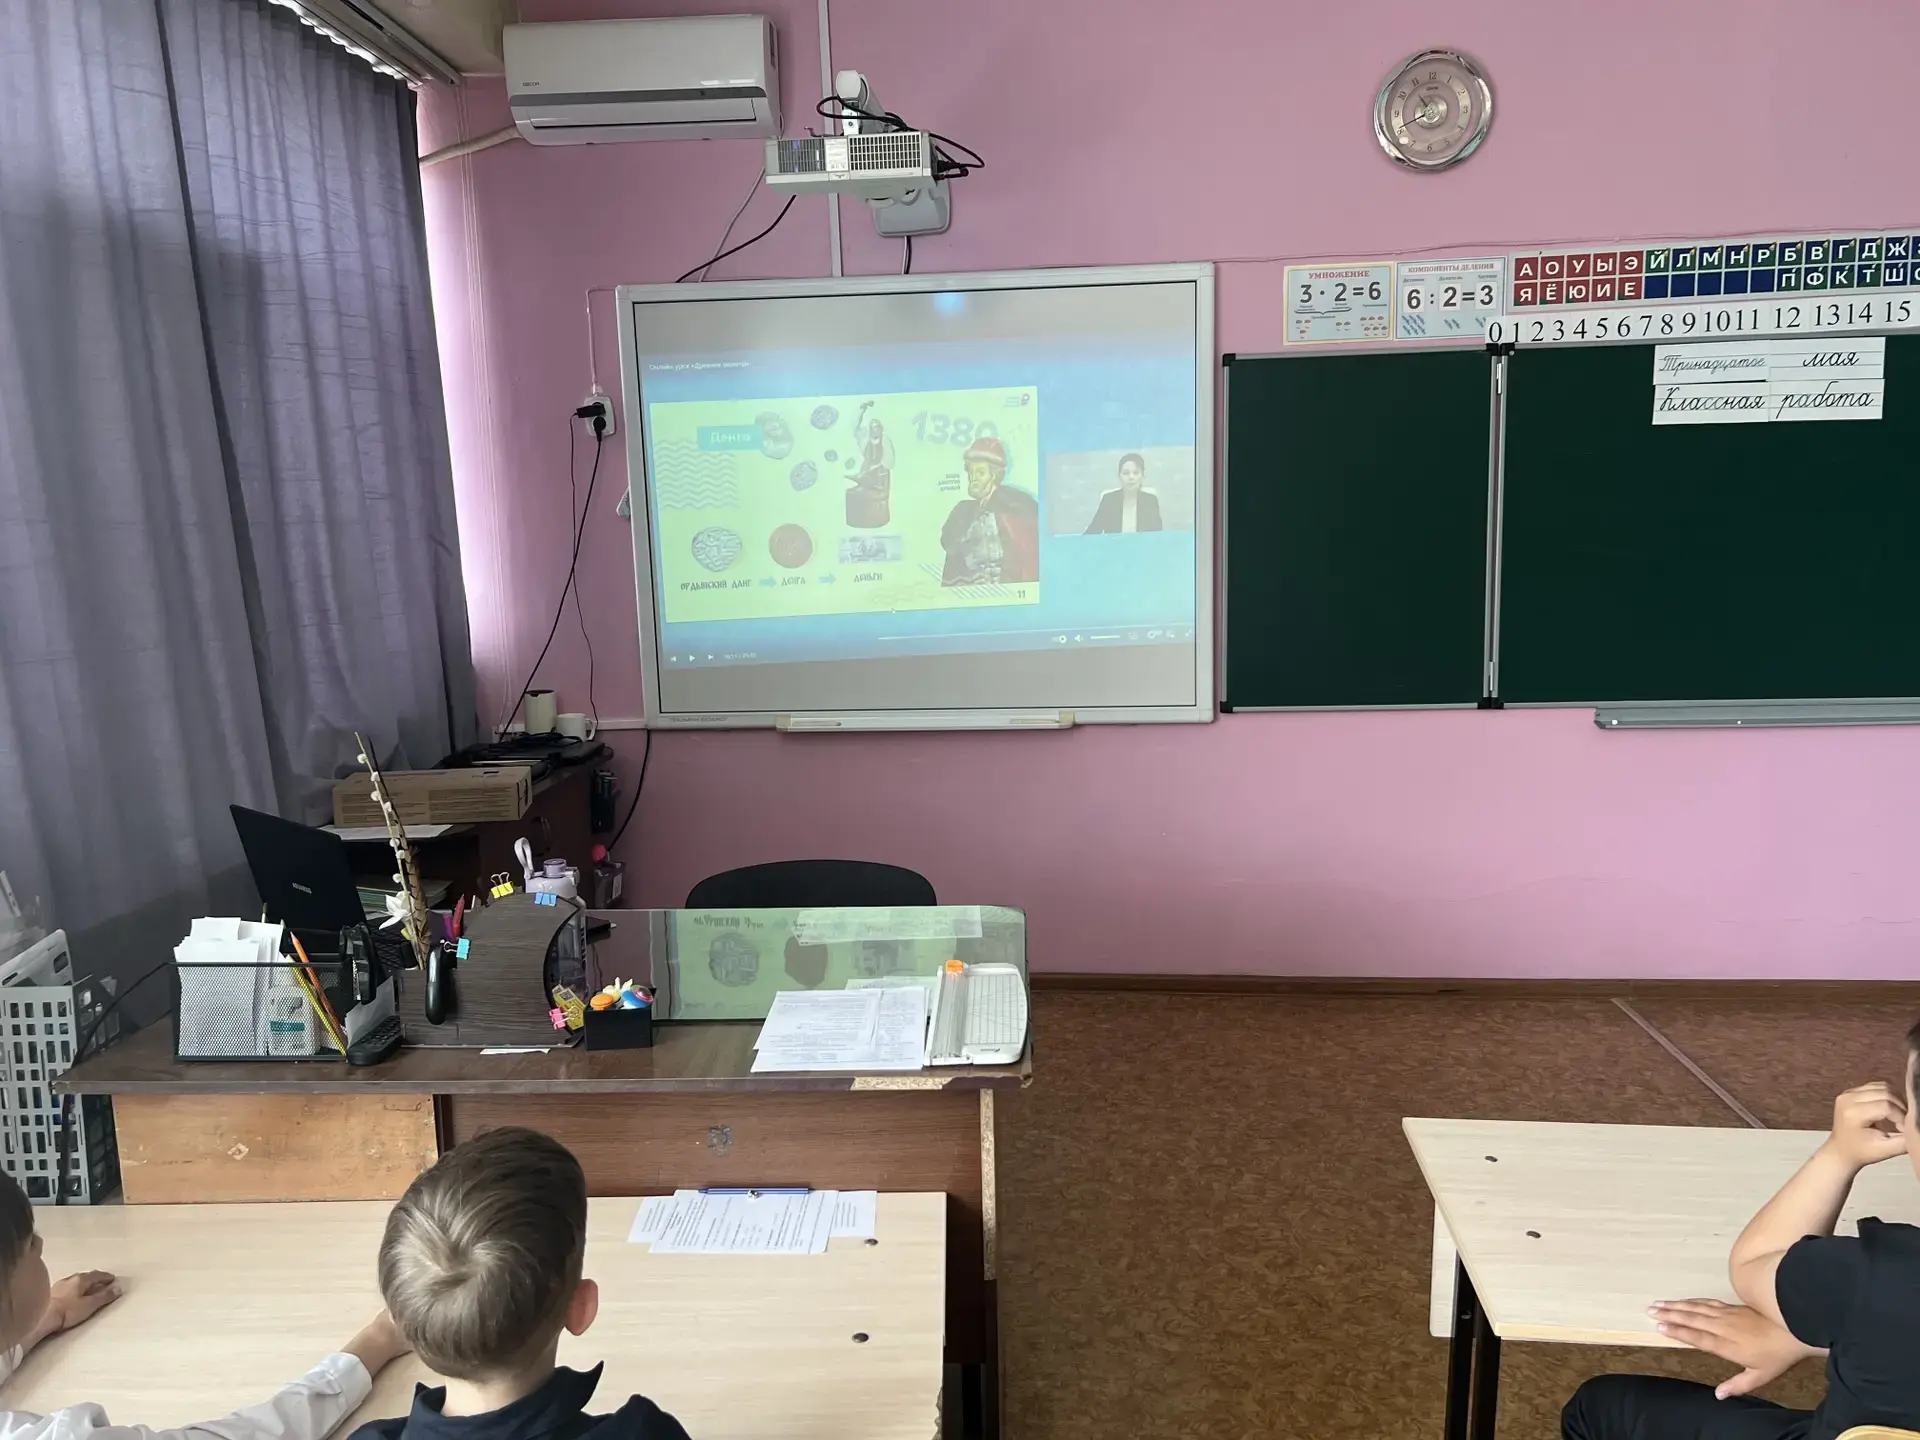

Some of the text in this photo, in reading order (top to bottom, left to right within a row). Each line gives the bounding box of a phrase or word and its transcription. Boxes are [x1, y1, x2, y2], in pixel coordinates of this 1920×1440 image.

[1428, 71, 1437, 80] 12
[1411, 77, 1419, 87] 11
[1398, 91, 1407, 100] 10
[1394, 110, 1400, 118] 9
[1463, 105, 1469, 114] 3
[1410, 140, 1416, 148] 7
[1427, 143, 1433, 152] 6
[1520, 263, 1533, 276] А
[1545, 261, 1560, 275] О
[1572, 259, 1585, 273] У
[1596, 258, 1613, 272] Ы
[1624, 256, 1638, 270] Э
[1650, 251, 1665, 269] Й
[1676, 253, 1690, 268] Л
[1703, 252, 1720, 266] М
[1730, 250, 1744, 265] Н
[1757, 249, 1770, 263] Р
[1784, 247, 1796, 261] Б
[1811, 246, 1823, 260] В
[1838, 244, 1849, 258] Г
[1862, 242, 1877, 259] Д
[1887, 242, 1907, 256] Ж
[1408, 263, 1495, 273] КОМПОНЕНТЫ ДЕЛЕНИЯ
[1308, 270, 1370, 279] УМНОЖЕНИЕ
[1520, 288, 1532, 302] Я
[1546, 284, 1557, 300] Ё
[1569, 285, 1586, 299] Ю
[1597, 283, 1611, 297] И
[1624, 282, 1636, 296] Е
[1488, 300, 1911, 343] 0 1 2 3 4 5 6 7 8 9 10 11 12 13 14 15
[1659, 352, 1860, 376] Тринадцатое мая
[1660, 381, 1875, 419] Классная работа
